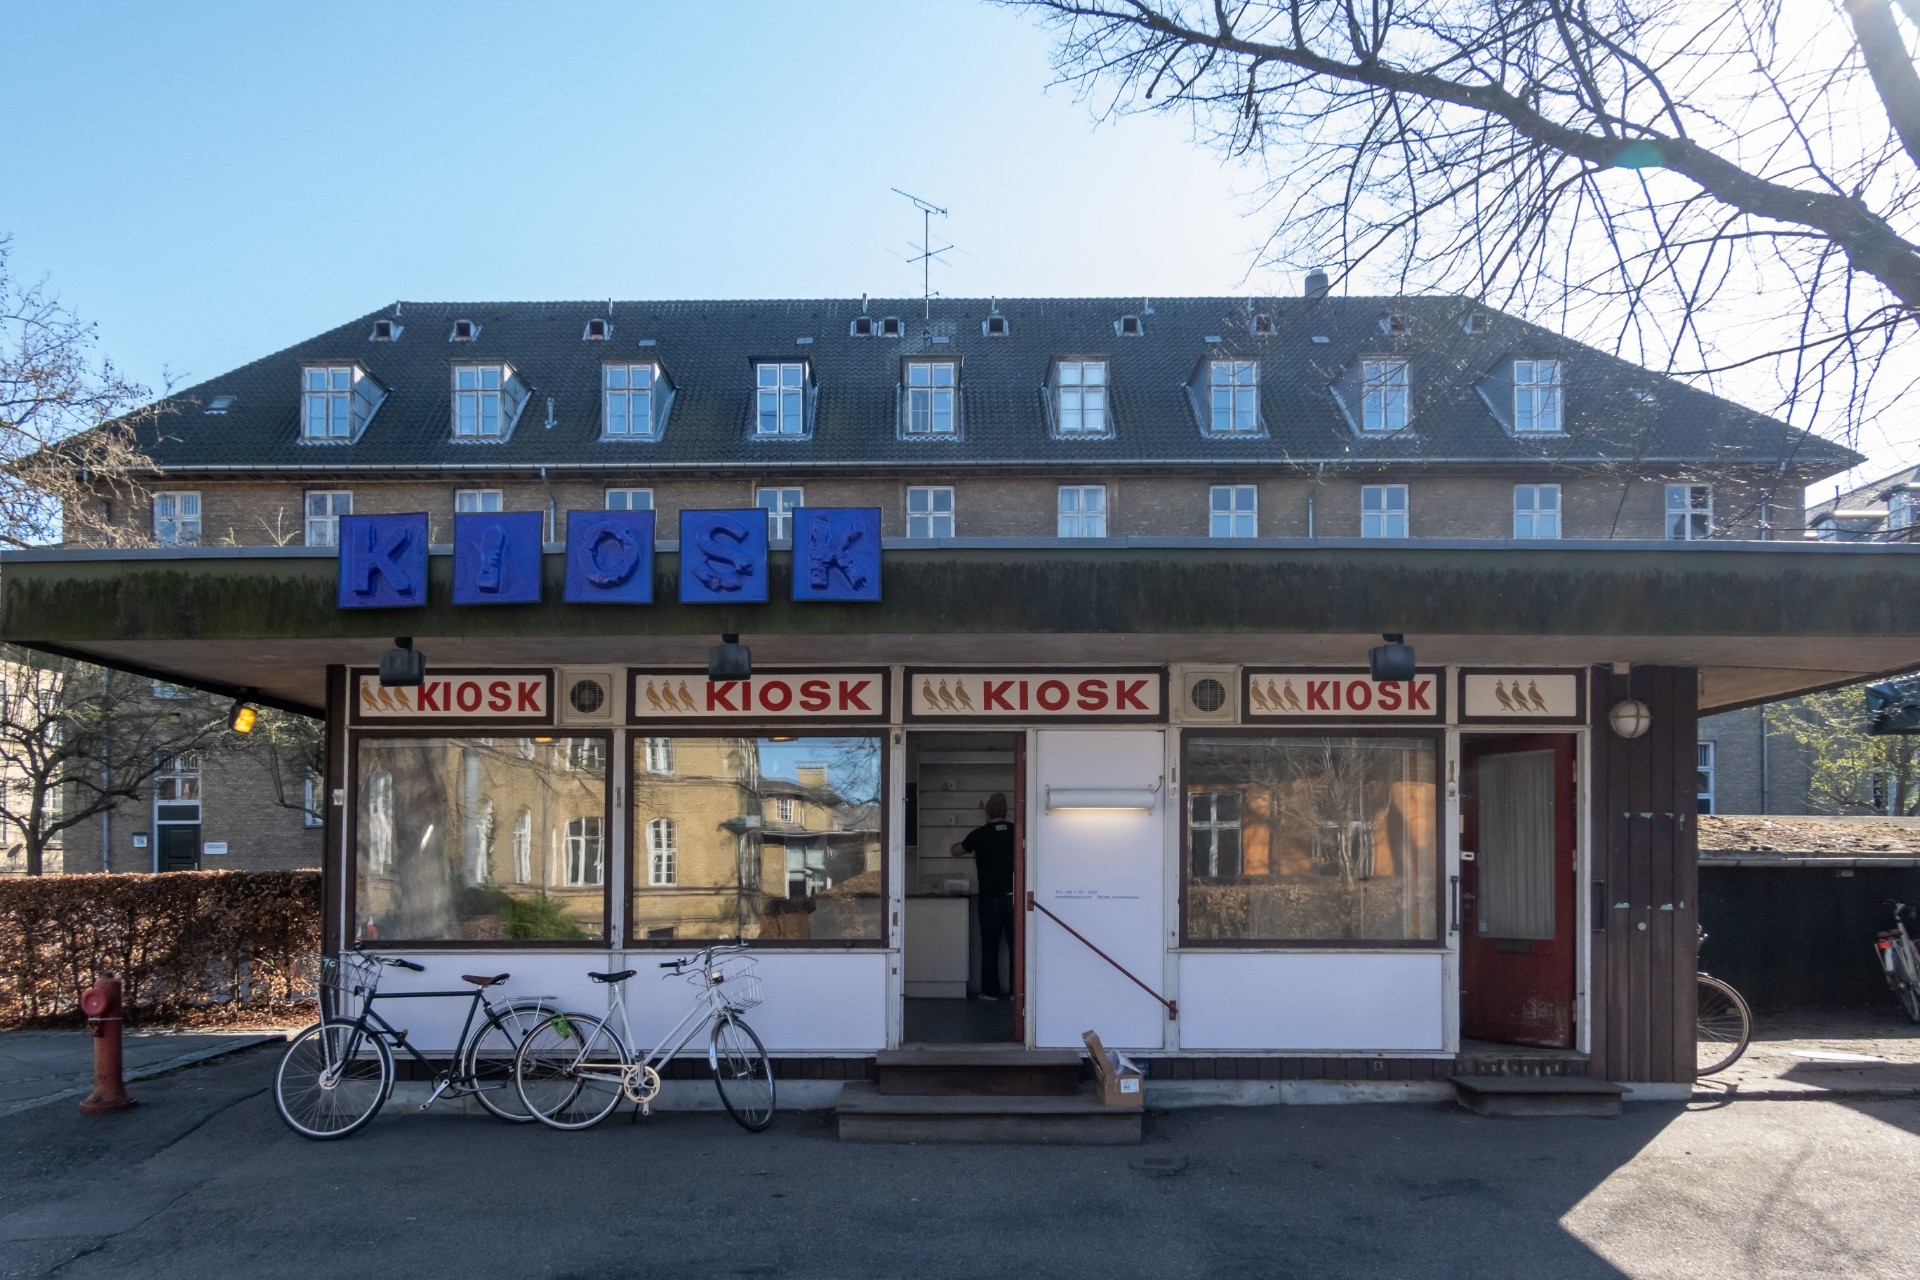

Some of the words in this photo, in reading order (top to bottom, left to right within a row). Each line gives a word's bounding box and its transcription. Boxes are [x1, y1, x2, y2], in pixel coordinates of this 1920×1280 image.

[352, 513, 869, 596] KIOSK
[417, 681, 542, 712] KIOSK
[706, 680, 872, 712] KIOSK
[983, 680, 1150, 711] KIOSK
[1306, 680, 1431, 711] KIOSK
